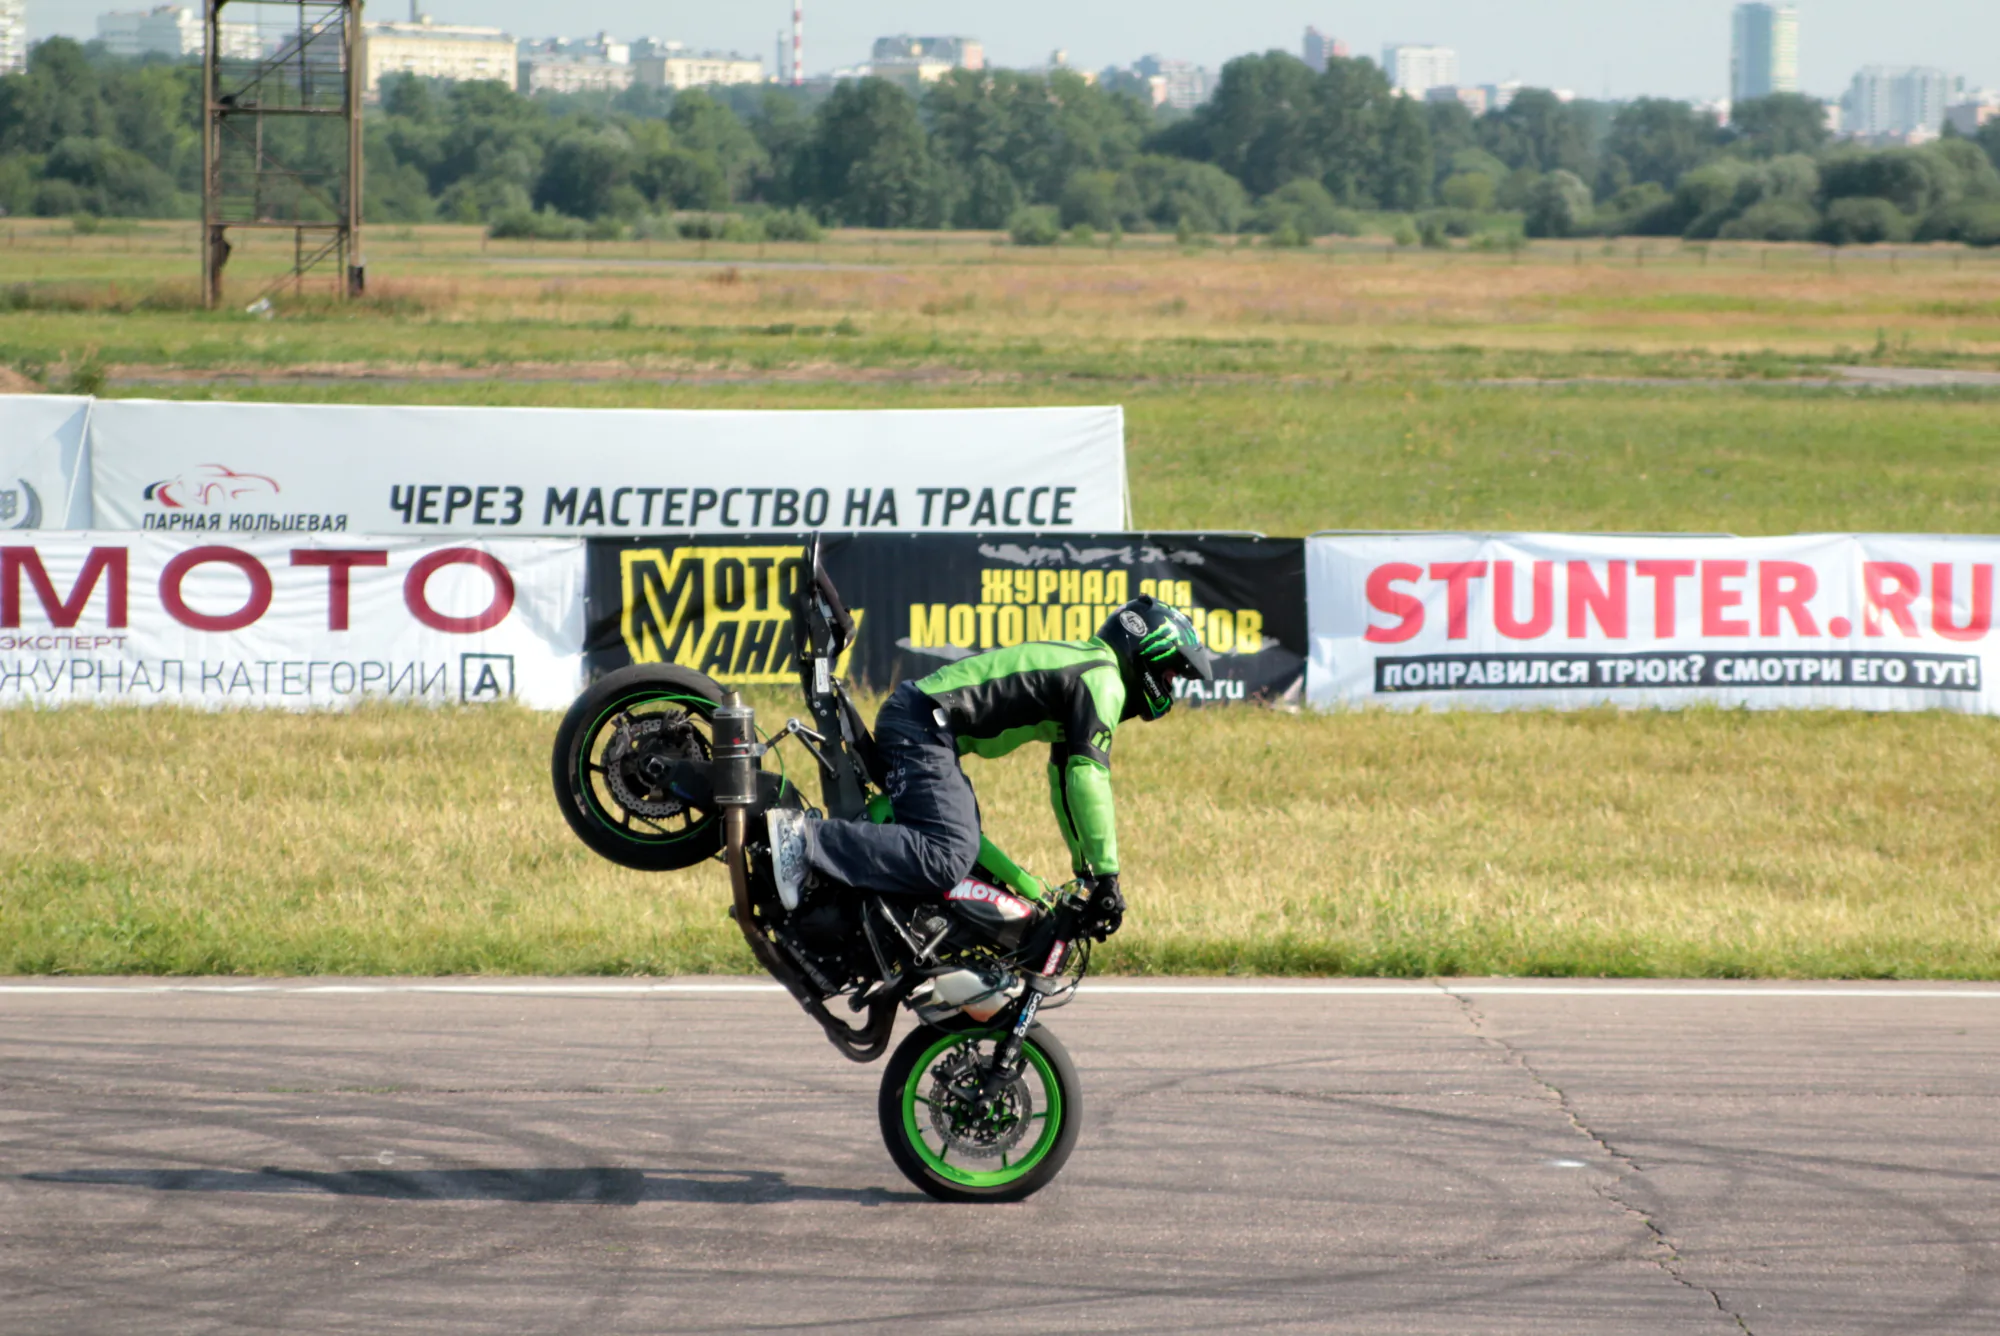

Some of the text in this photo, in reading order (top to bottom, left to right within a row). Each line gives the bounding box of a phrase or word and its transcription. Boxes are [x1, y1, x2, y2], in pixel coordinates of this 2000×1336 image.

[142, 513, 348, 531] ПАРНАЯ КОЛЬЦЕВАЯ
[390, 484, 1077, 527] ЧЕРЕЗ МАСТЕРСТВО НА ТРАССЕ
[0, 545, 515, 634] МОТО
[981, 569, 1128, 604] ЖУРНАЛ
[1364, 559, 1993, 644] STUNTER.RU
[0, 636, 128, 650] ЭКСПЕРТ
[910, 604, 1264, 653] МОТОМАКОВ
[0, 659, 183, 694] ЖУРНАЛ
[202, 660, 446, 695] КАТЕГОРИИ
[1171, 676, 1245, 699] YA.ru
[1383, 655, 1977, 686] ПОНРАВИЛСЯ ТРЮК? СМОТРИ ЕГО ТУТ!
